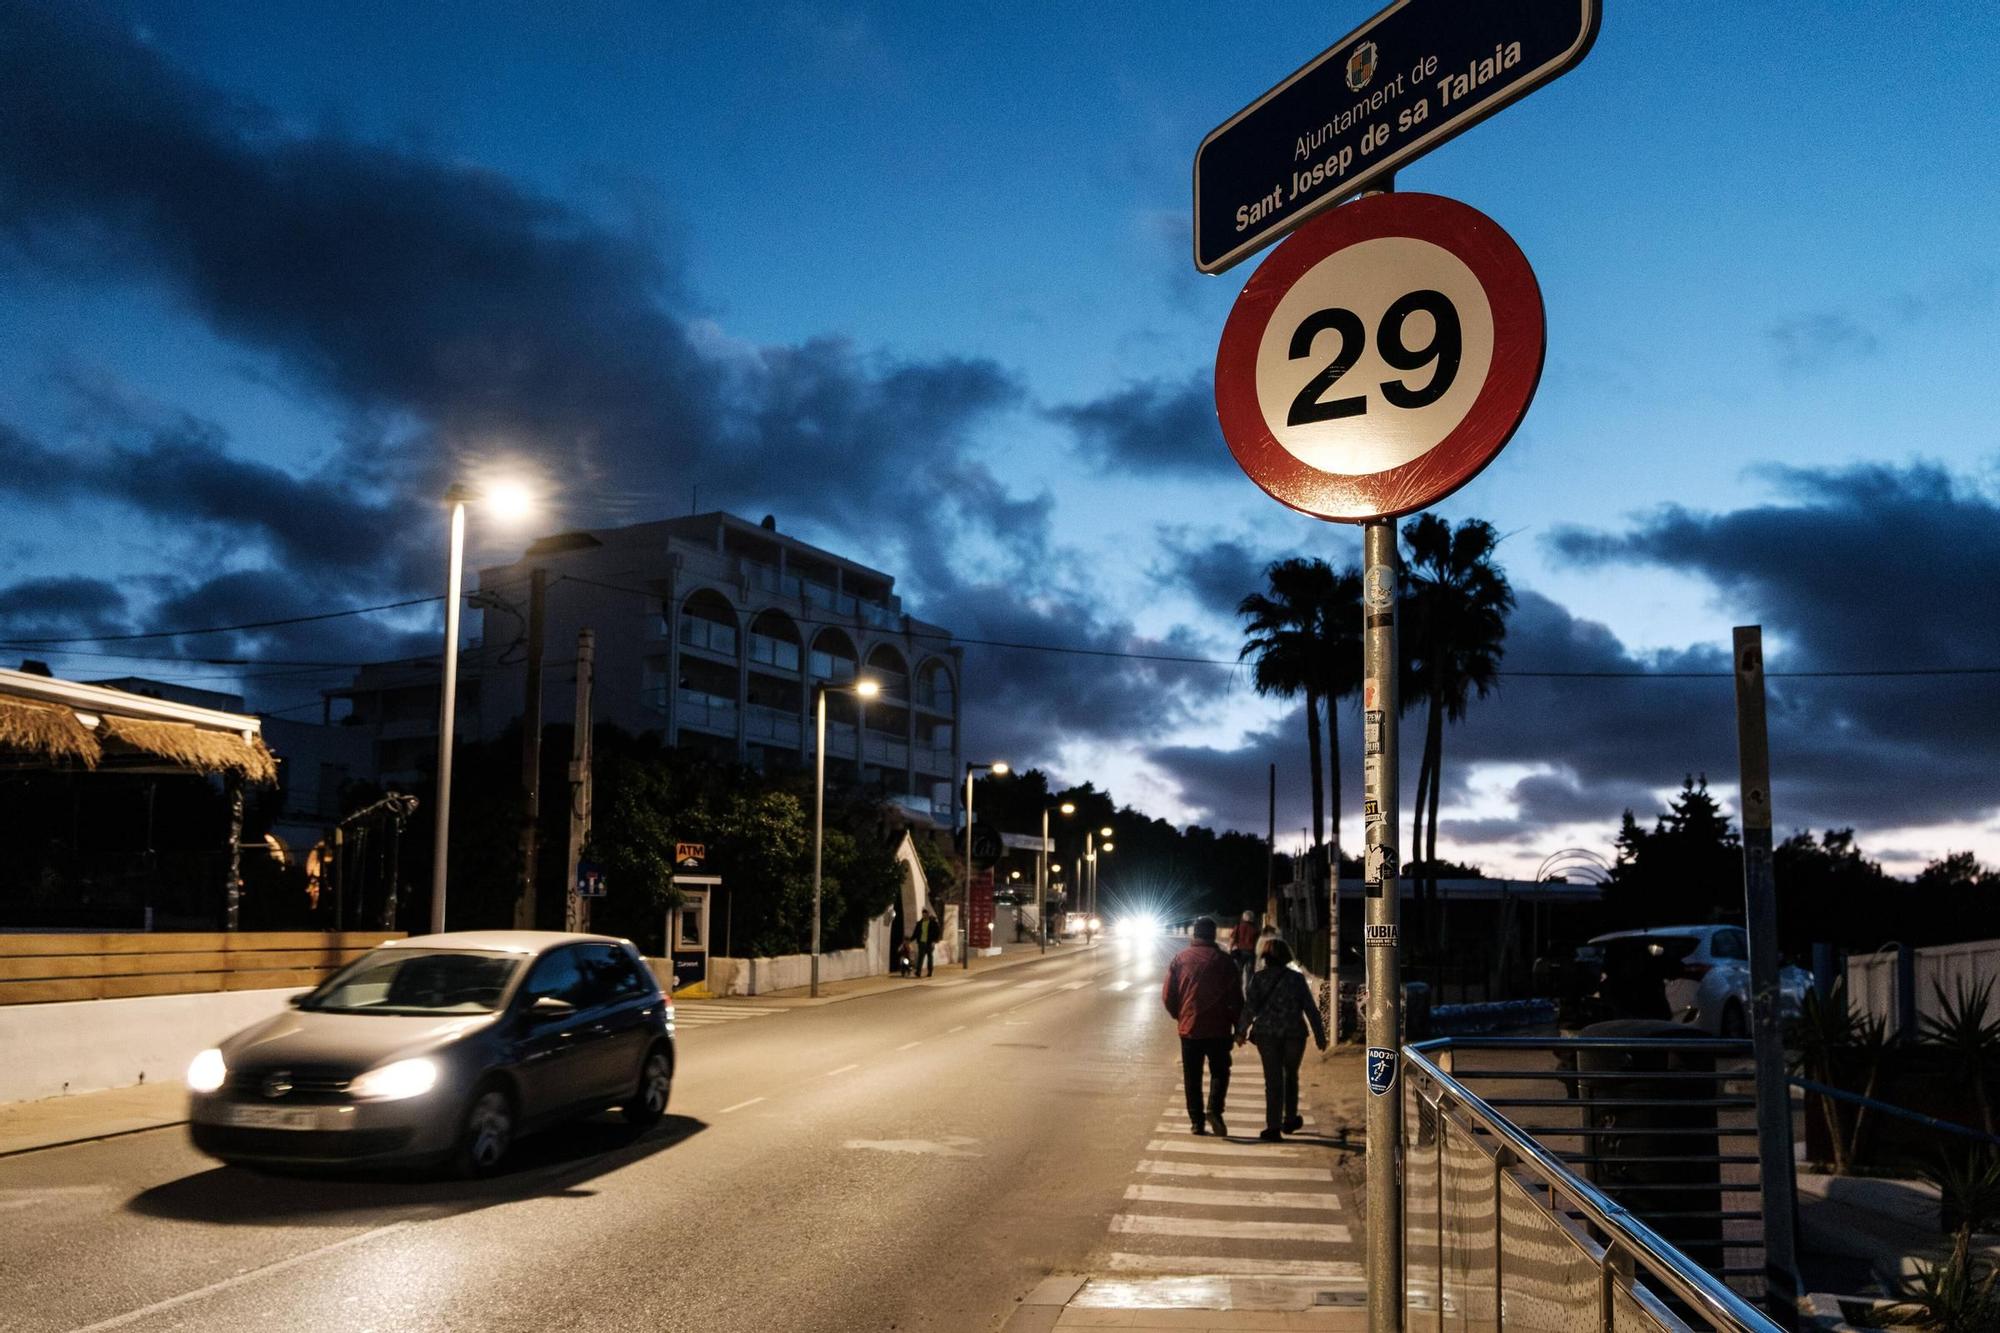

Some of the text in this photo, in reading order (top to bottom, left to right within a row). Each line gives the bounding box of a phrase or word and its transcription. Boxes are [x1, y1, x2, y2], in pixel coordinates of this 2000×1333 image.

[1235, 40, 1522, 232] Sant Josep de sa Talaia
[1294, 54, 1438, 162] Ajuntament de
[1287, 289, 1462, 427] 29
[678, 844, 704, 856] ATM
